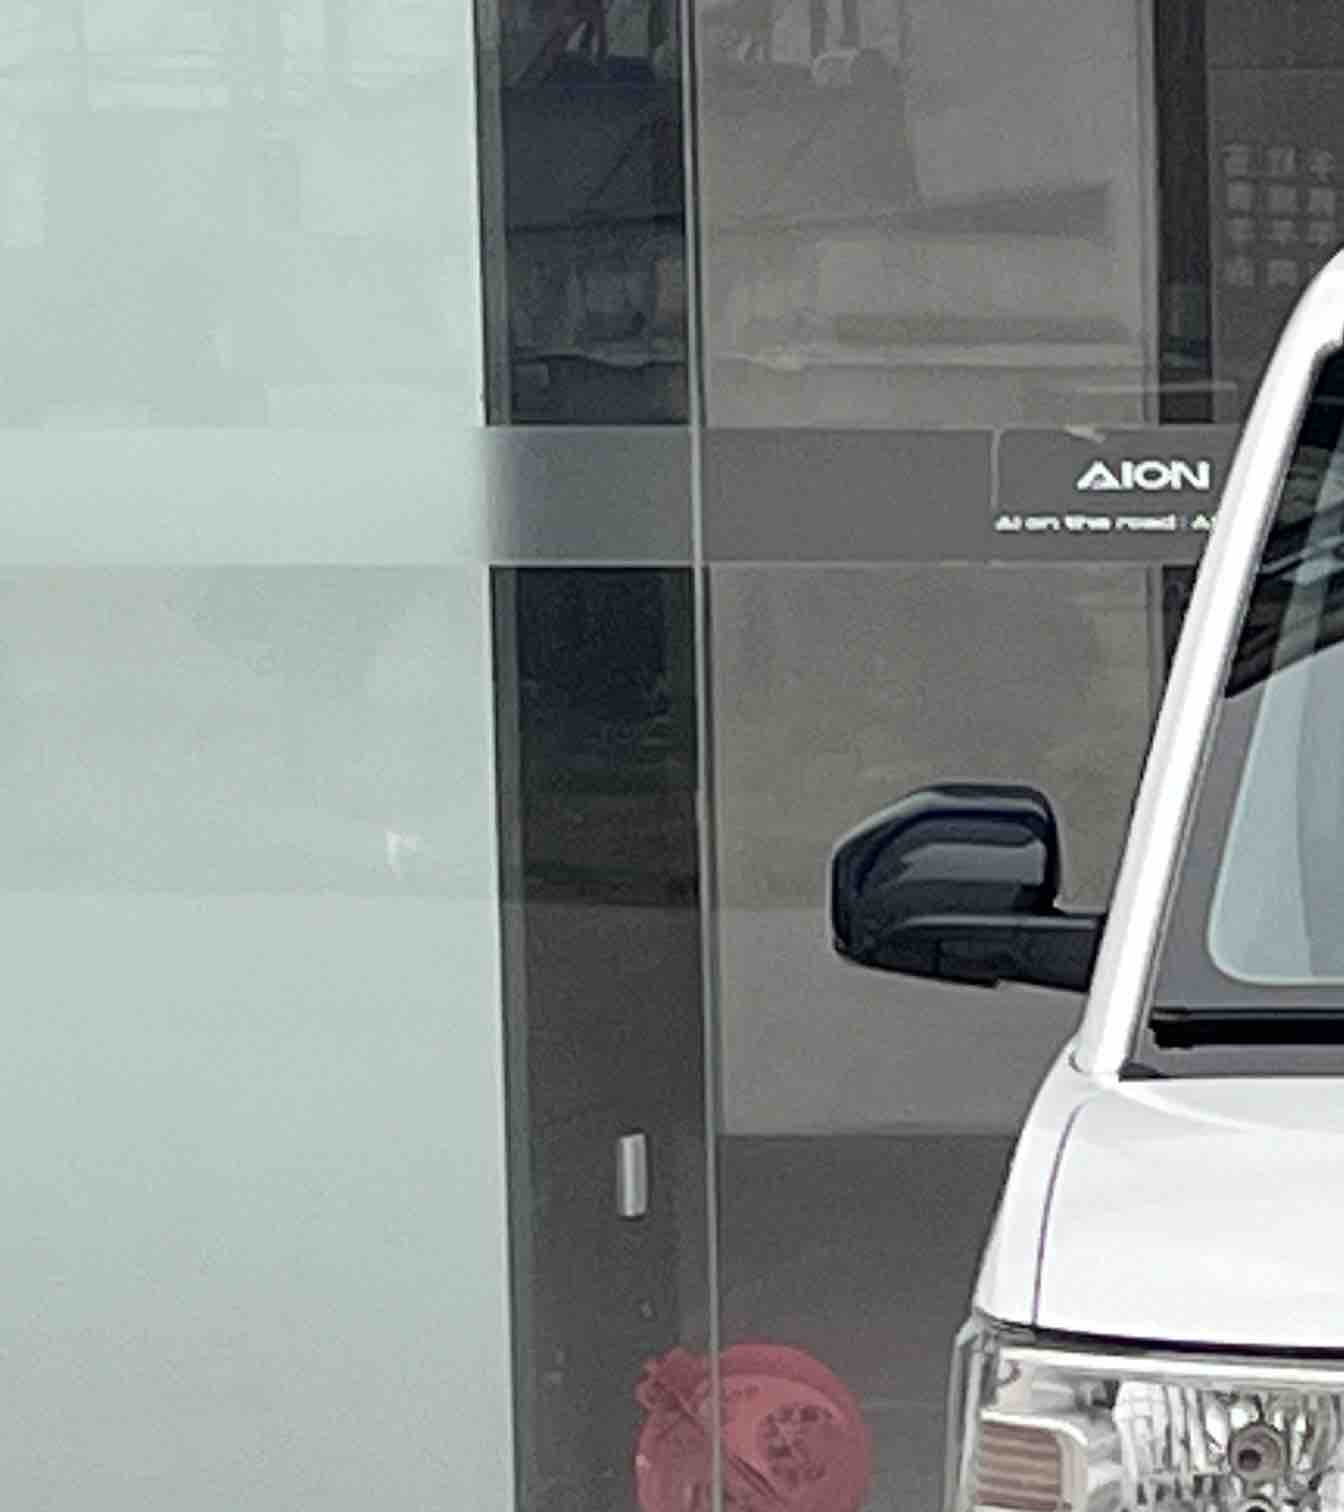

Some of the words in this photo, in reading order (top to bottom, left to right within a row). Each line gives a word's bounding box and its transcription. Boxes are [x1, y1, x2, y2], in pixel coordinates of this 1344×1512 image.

[1076, 460, 1210, 490] AION
[1025, 515, 1060, 532] on
[1064, 514, 1111, 532] the
[1115, 513, 1177, 532] road
